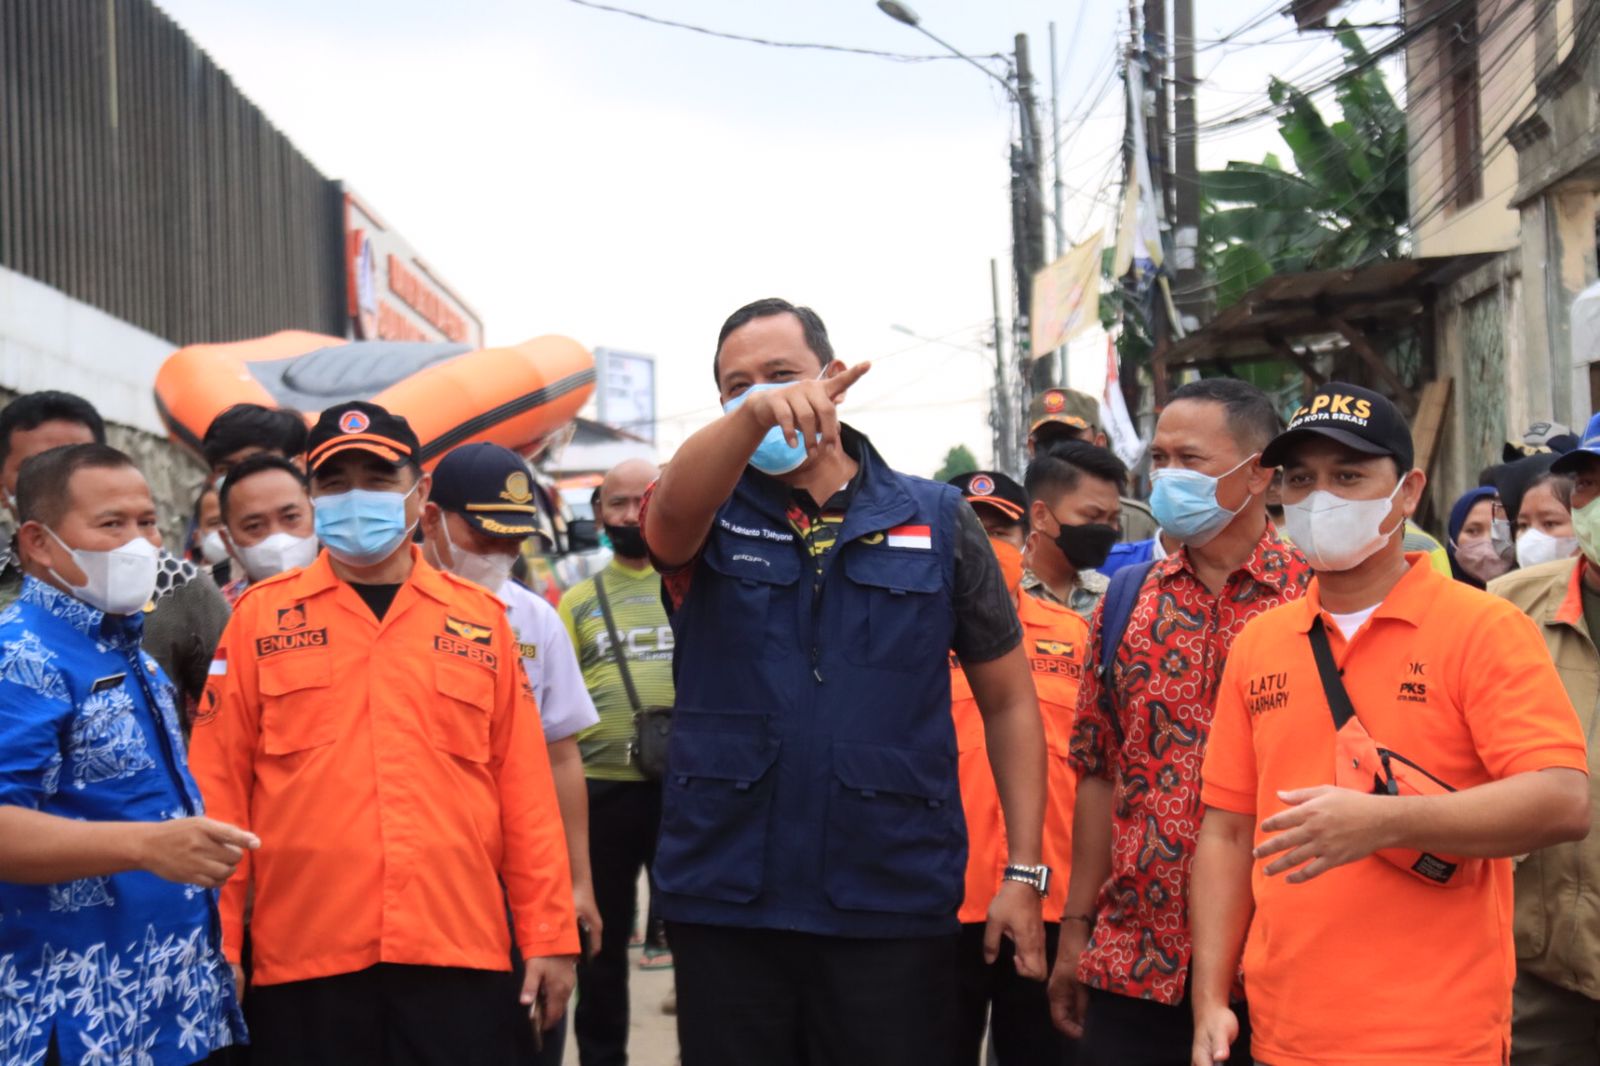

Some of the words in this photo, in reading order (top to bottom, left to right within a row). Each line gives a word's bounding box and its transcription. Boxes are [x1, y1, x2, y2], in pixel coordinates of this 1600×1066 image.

[1310, 393, 1372, 419] PKS
[1304, 412, 1330, 423] KOTA
[1332, 413, 1368, 427] BEKASI
[260, 631, 324, 655] ENUNG
[437, 637, 496, 667] BPBD
[1033, 659, 1078, 677] BPBD
[1250, 672, 1288, 696] LATU
[1399, 682, 1426, 695] PKS
